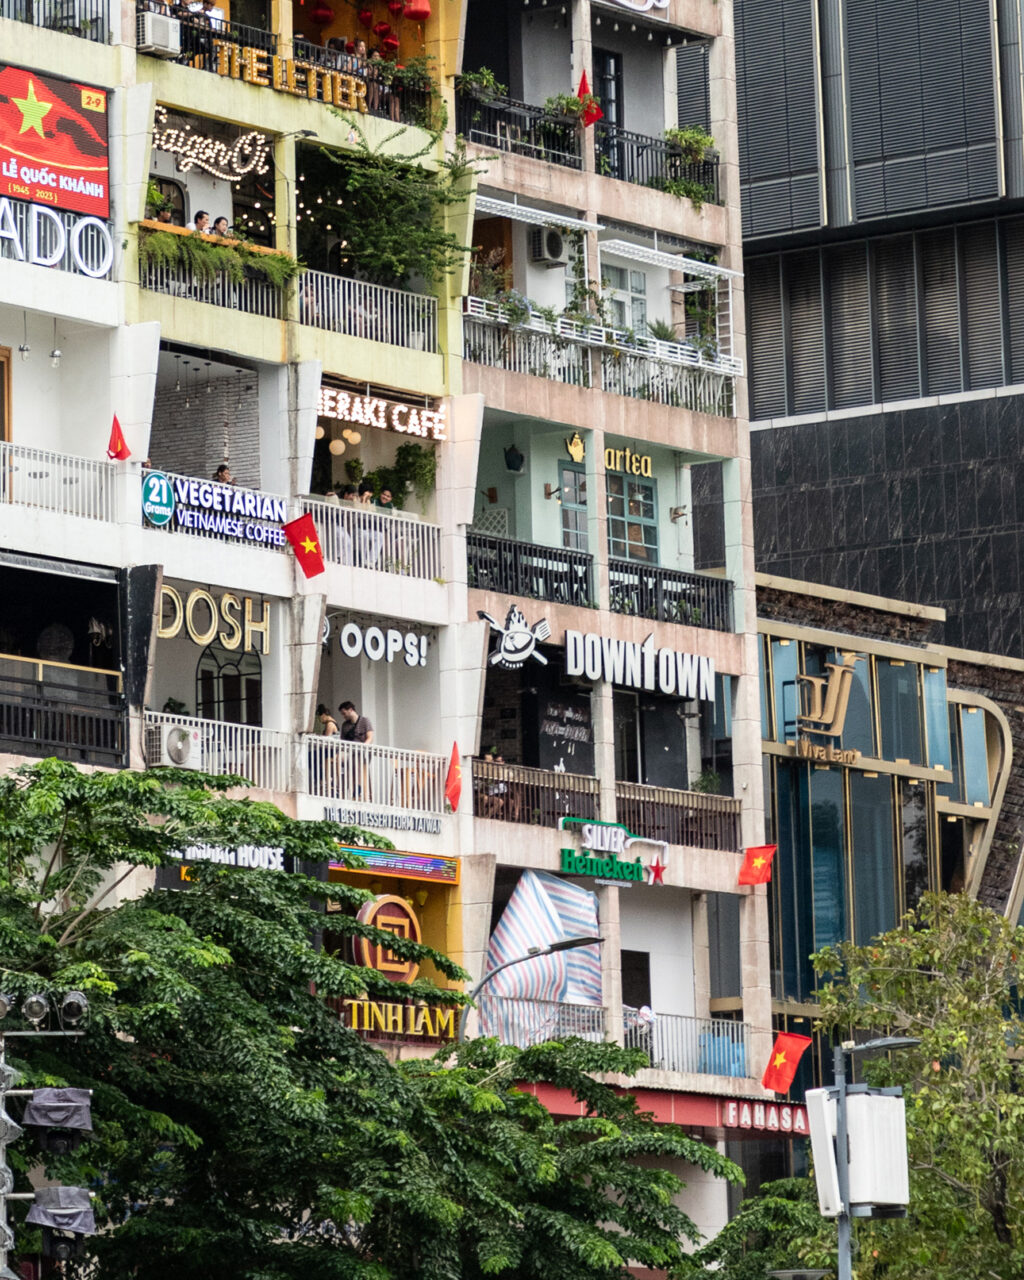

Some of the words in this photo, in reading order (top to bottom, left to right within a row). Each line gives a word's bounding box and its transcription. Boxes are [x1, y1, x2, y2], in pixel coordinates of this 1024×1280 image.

[212, 38, 269, 86] THE
[273, 55, 369, 113] LETTER
[59, 175, 104, 199] KHÁNH
[148, 477, 168, 504] 21
[175, 479, 287, 523] VEGETARIAN
[144, 501, 172, 516] Grams
[176, 508, 244, 537] VIETNAMESE
[245, 523, 286, 546] COFFEE
[157, 584, 271, 655] DOSH
[340, 622, 427, 667] OOPS!
[582, 824, 626, 853] SILVER
[237, 843, 284, 871] HOUSE
[560, 849, 643, 881] Heineken
[728, 1102, 805, 1131] FAHASA
